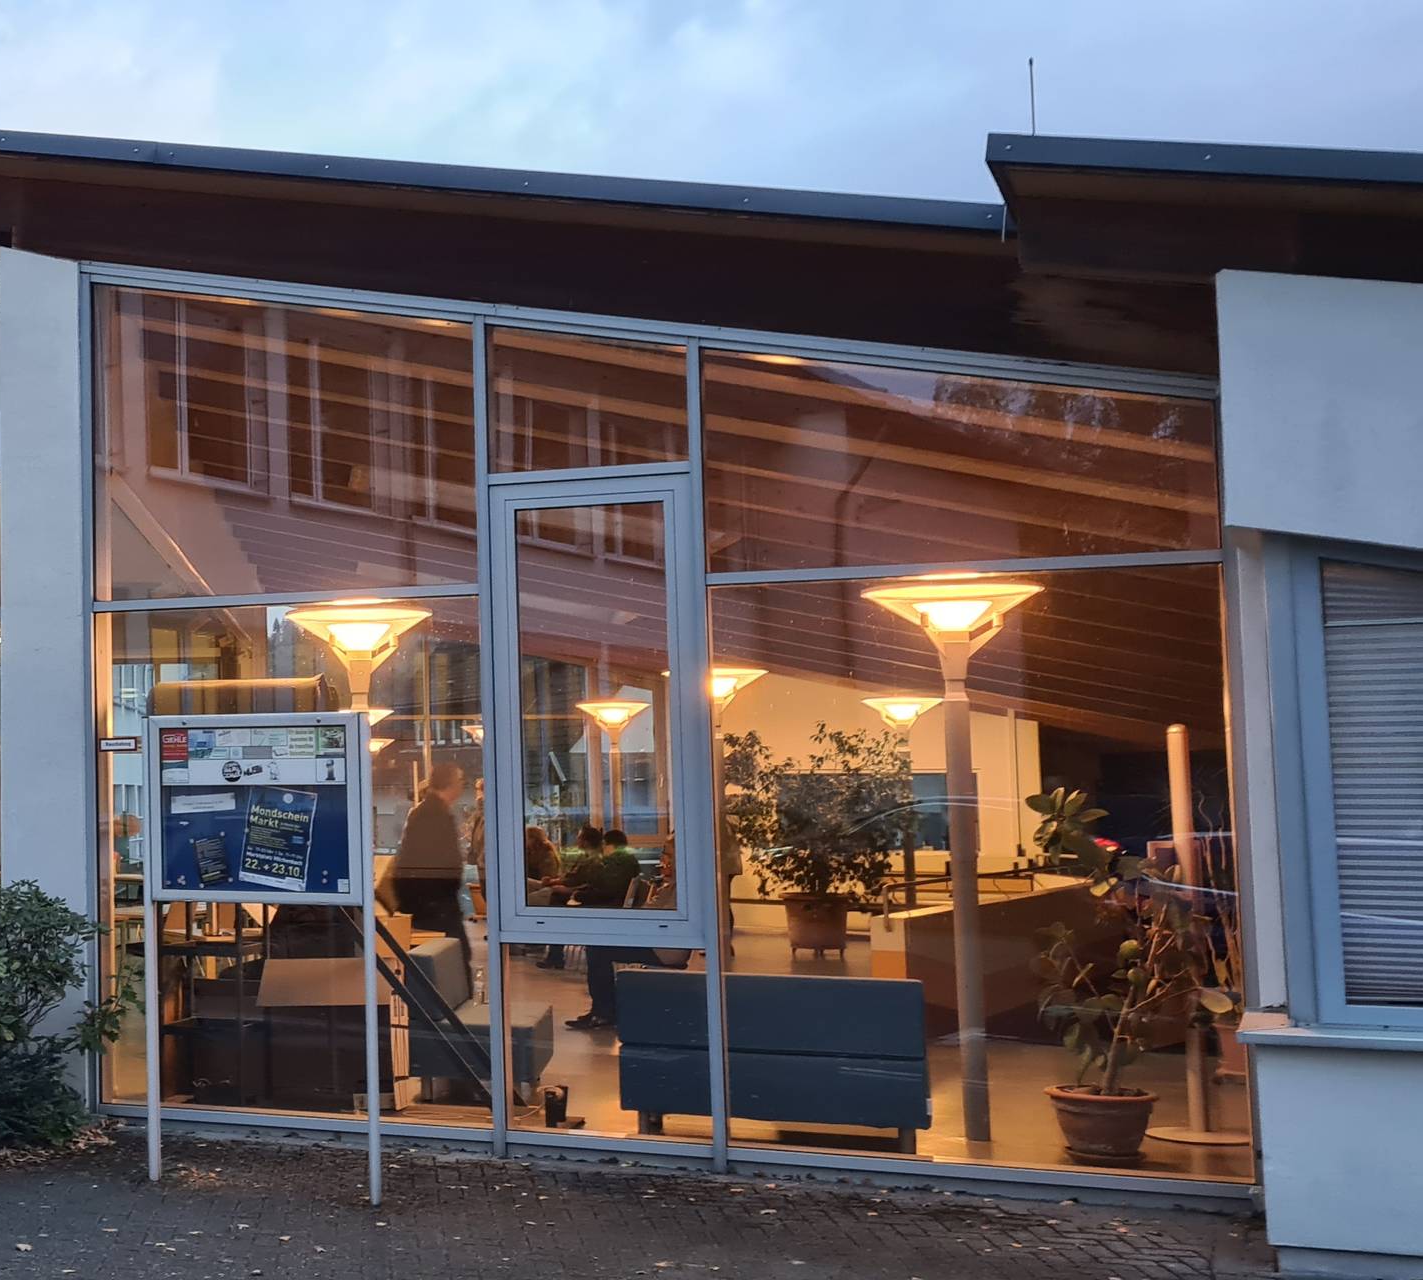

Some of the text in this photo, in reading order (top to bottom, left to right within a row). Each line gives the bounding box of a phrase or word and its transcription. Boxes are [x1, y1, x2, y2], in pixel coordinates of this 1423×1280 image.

[249, 815, 279, 828] Markt
[251, 804, 309, 823] Mondschein
[244, 858, 261, 870] 22.
[271, 863, 303, 878] 23.10.
